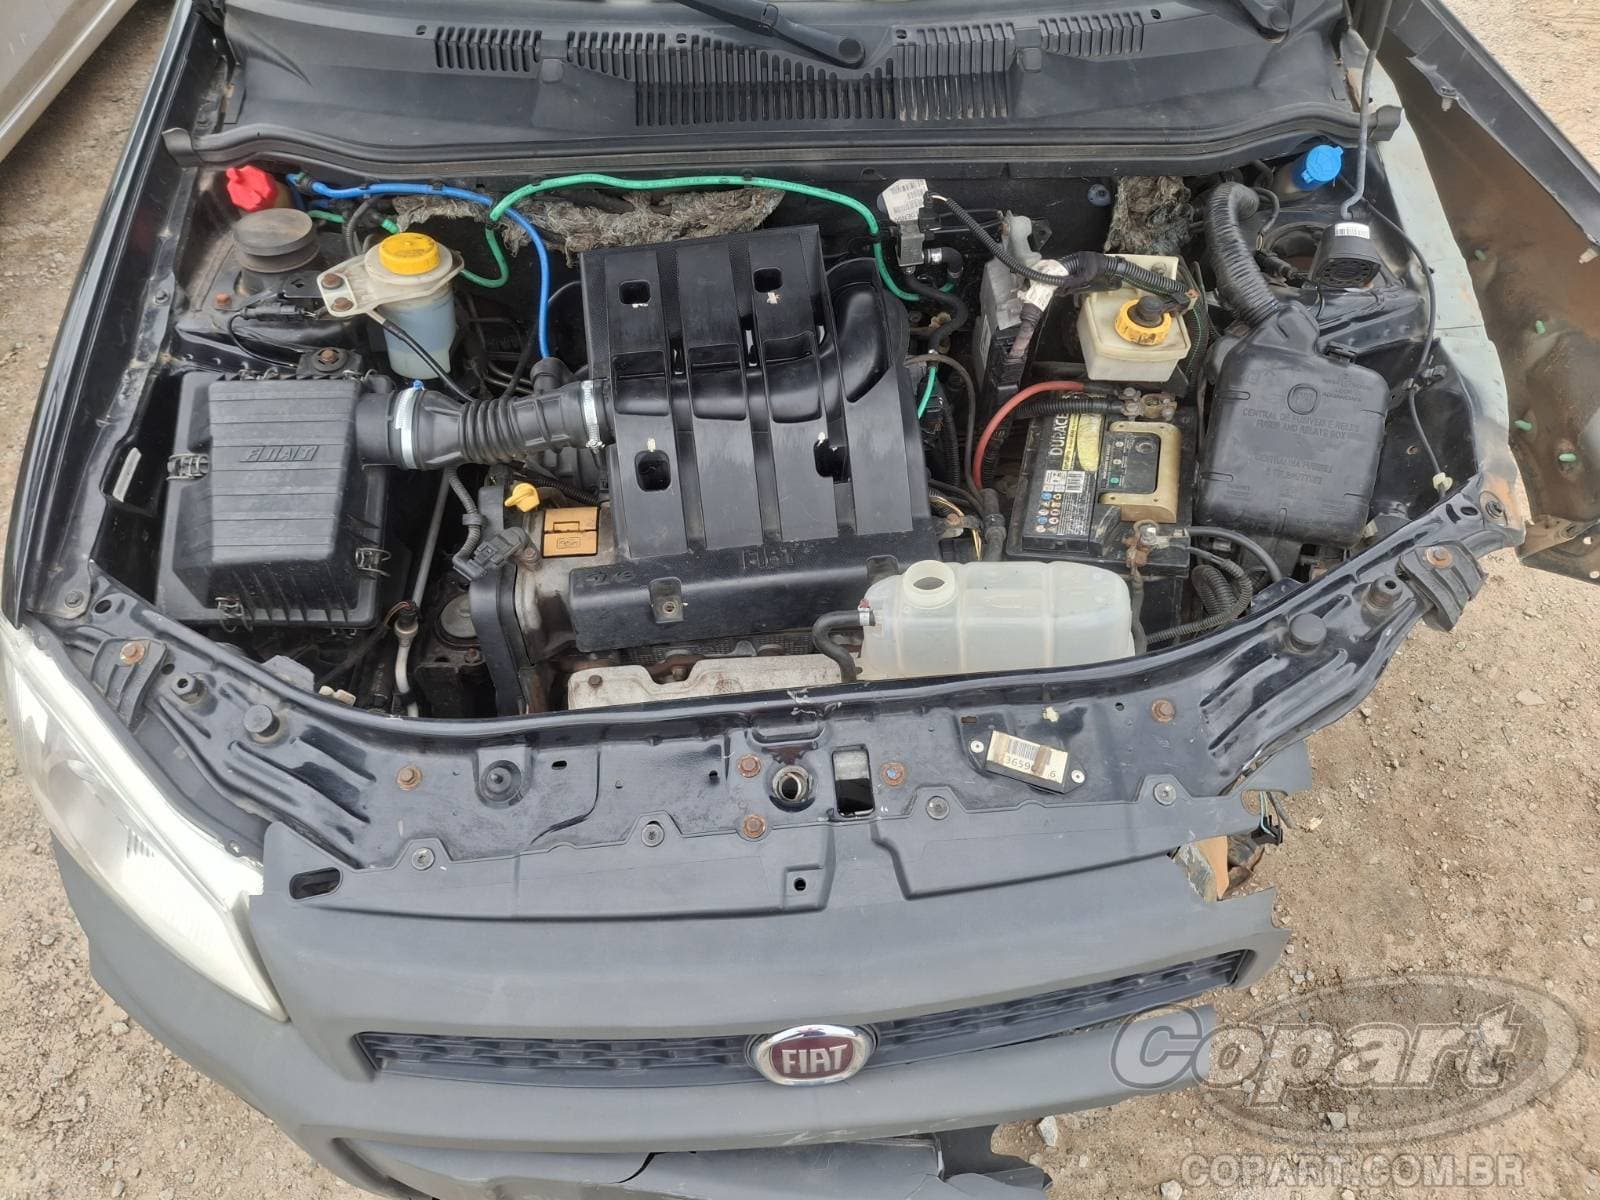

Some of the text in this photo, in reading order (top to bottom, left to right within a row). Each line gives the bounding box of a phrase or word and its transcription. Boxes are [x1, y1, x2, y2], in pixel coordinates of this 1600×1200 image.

[1050, 413, 1069, 456] DURACE
[246, 446, 318, 461] FIAT
[782, 1044, 848, 1074] FIAT
